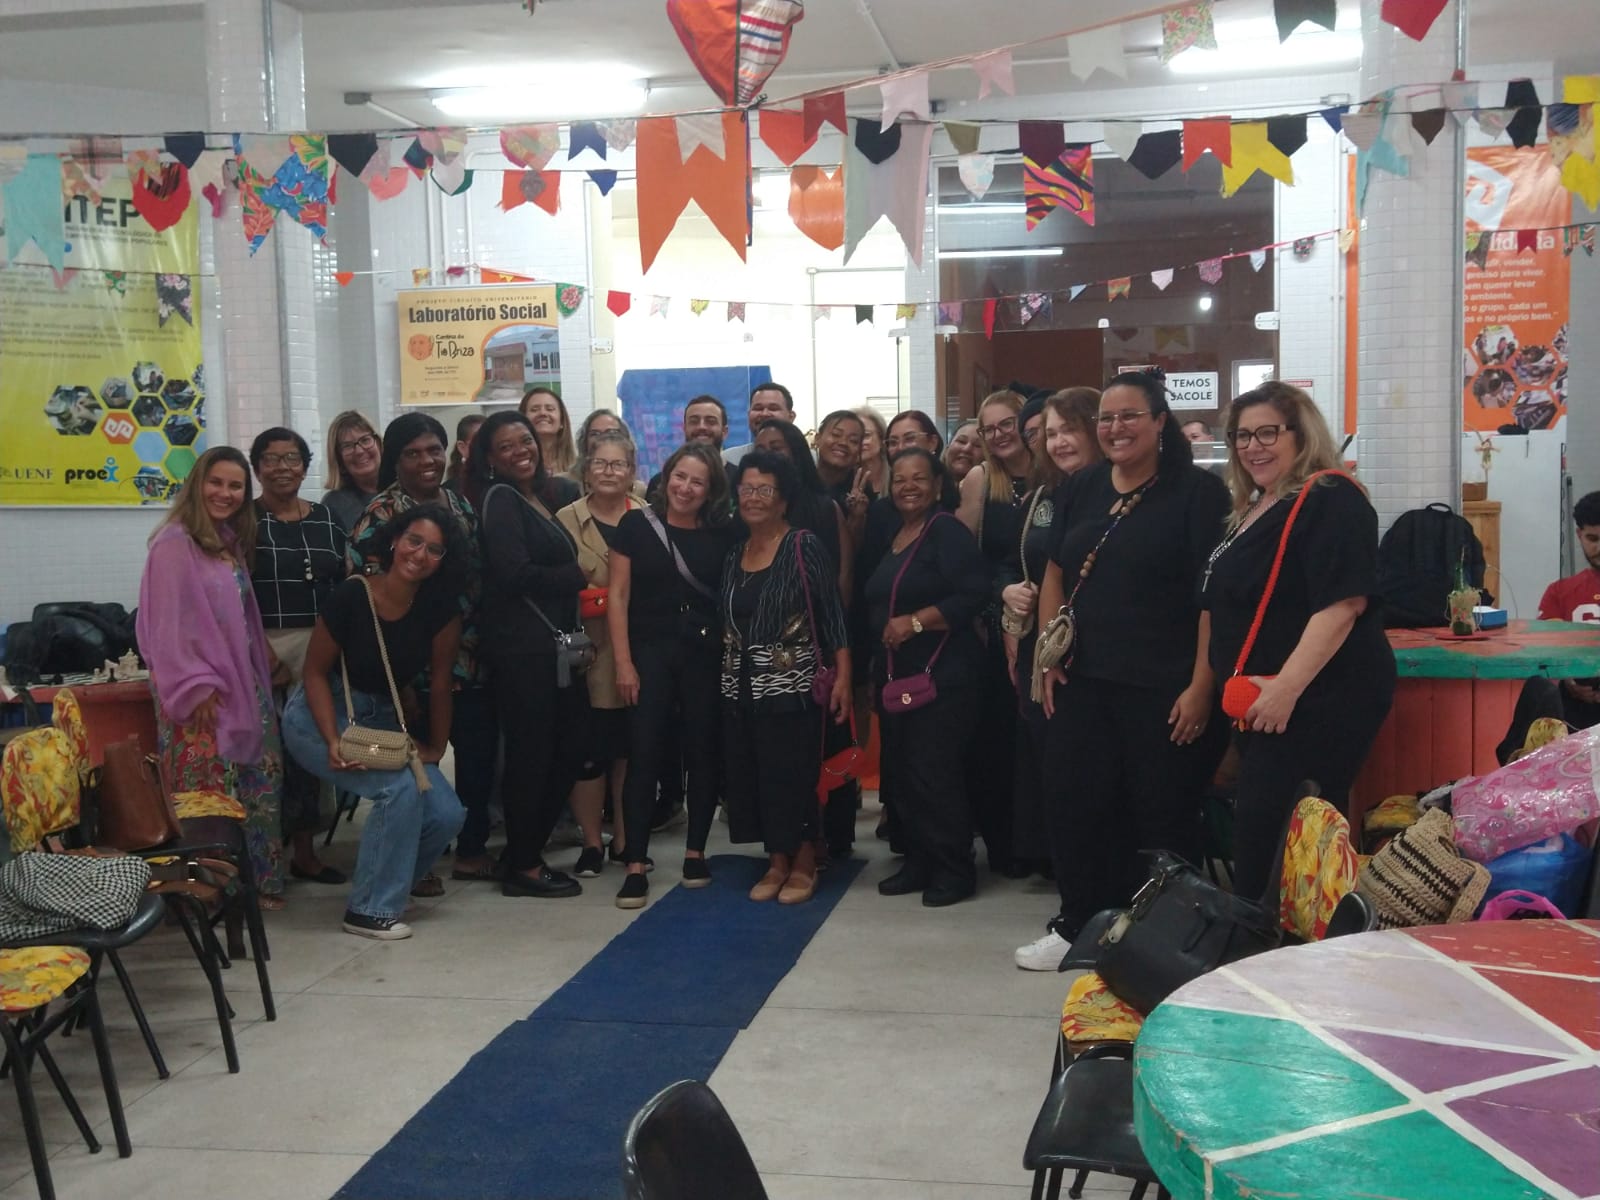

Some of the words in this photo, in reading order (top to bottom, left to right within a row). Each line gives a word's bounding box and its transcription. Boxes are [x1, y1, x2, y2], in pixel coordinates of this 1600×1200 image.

[409, 304, 496, 323] Laboratório
[500, 303, 547, 320] Social
[1172, 378, 1210, 388] TEMOS
